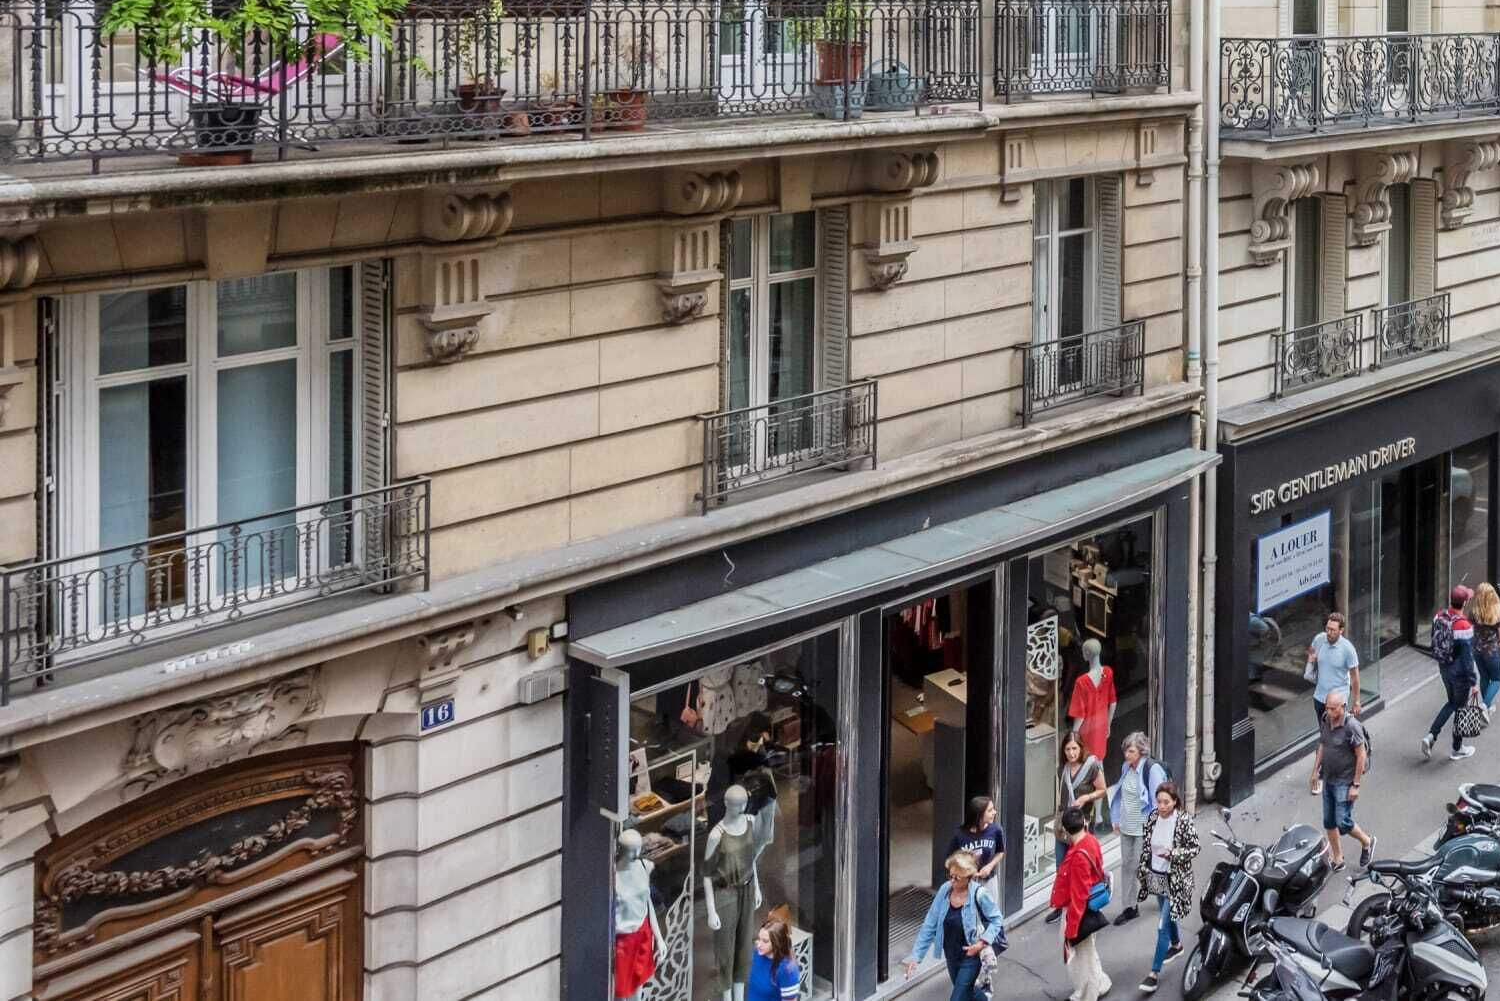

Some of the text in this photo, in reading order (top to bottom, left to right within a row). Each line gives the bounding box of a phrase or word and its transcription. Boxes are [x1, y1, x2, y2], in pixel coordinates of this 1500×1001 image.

[1250, 437, 1417, 515] SIR GENTLEMAN DRIVER
[1281, 530, 1318, 556] LOUER
[428, 704, 449, 726] 16
